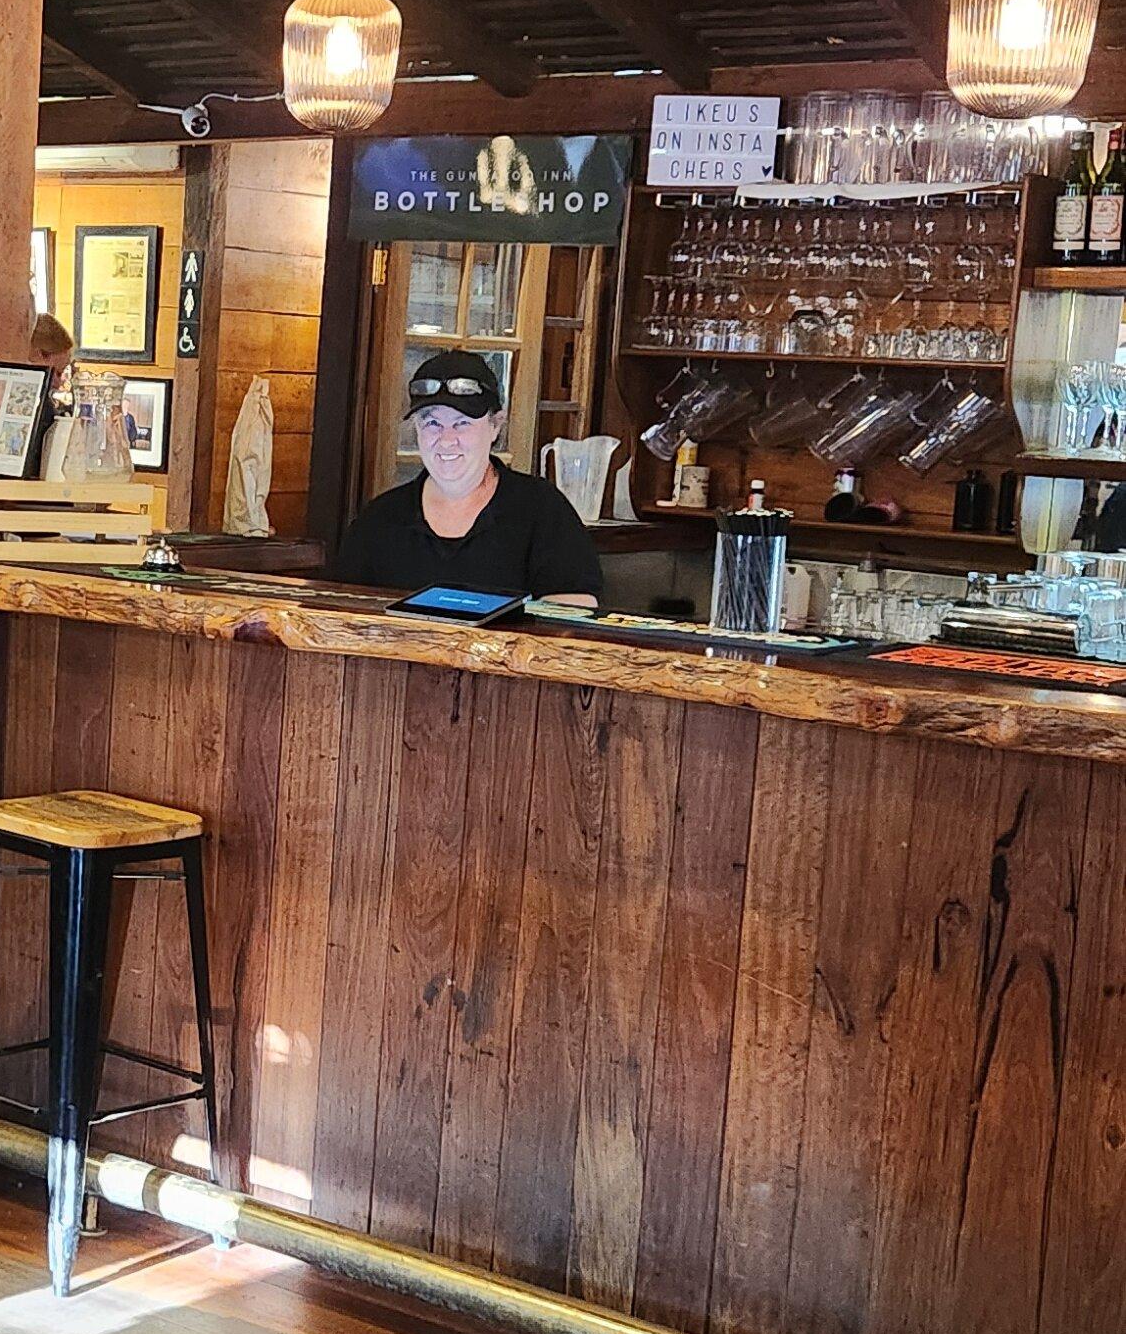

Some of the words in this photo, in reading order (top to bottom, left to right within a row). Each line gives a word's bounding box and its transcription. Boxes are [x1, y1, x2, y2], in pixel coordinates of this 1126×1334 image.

[656, 131, 682, 150] ON
[697, 133, 762, 152] INSTA
[411, 170, 438, 182] THE
[543, 170, 572, 182] INN
[670, 160, 742, 180] CHERS
[374, 191, 610, 213] BOTTLEHOP
